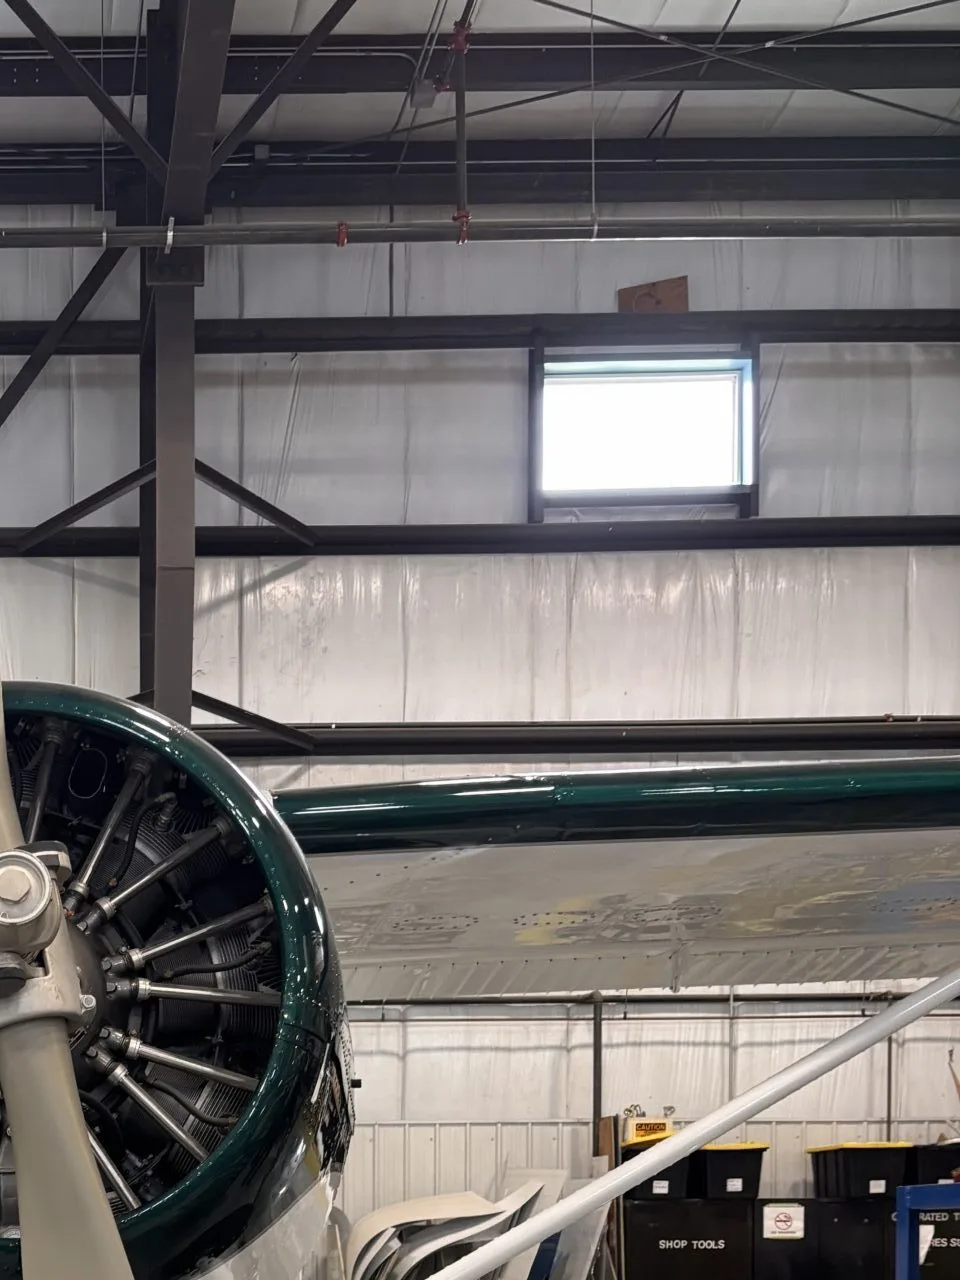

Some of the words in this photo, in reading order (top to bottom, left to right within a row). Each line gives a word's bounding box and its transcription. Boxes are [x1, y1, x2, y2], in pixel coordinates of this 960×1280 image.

[636, 1123, 665, 1131] CAUTION
[659, 1239, 688, 1249] SHOP
[691, 1239, 725, 1250] TOOLS
